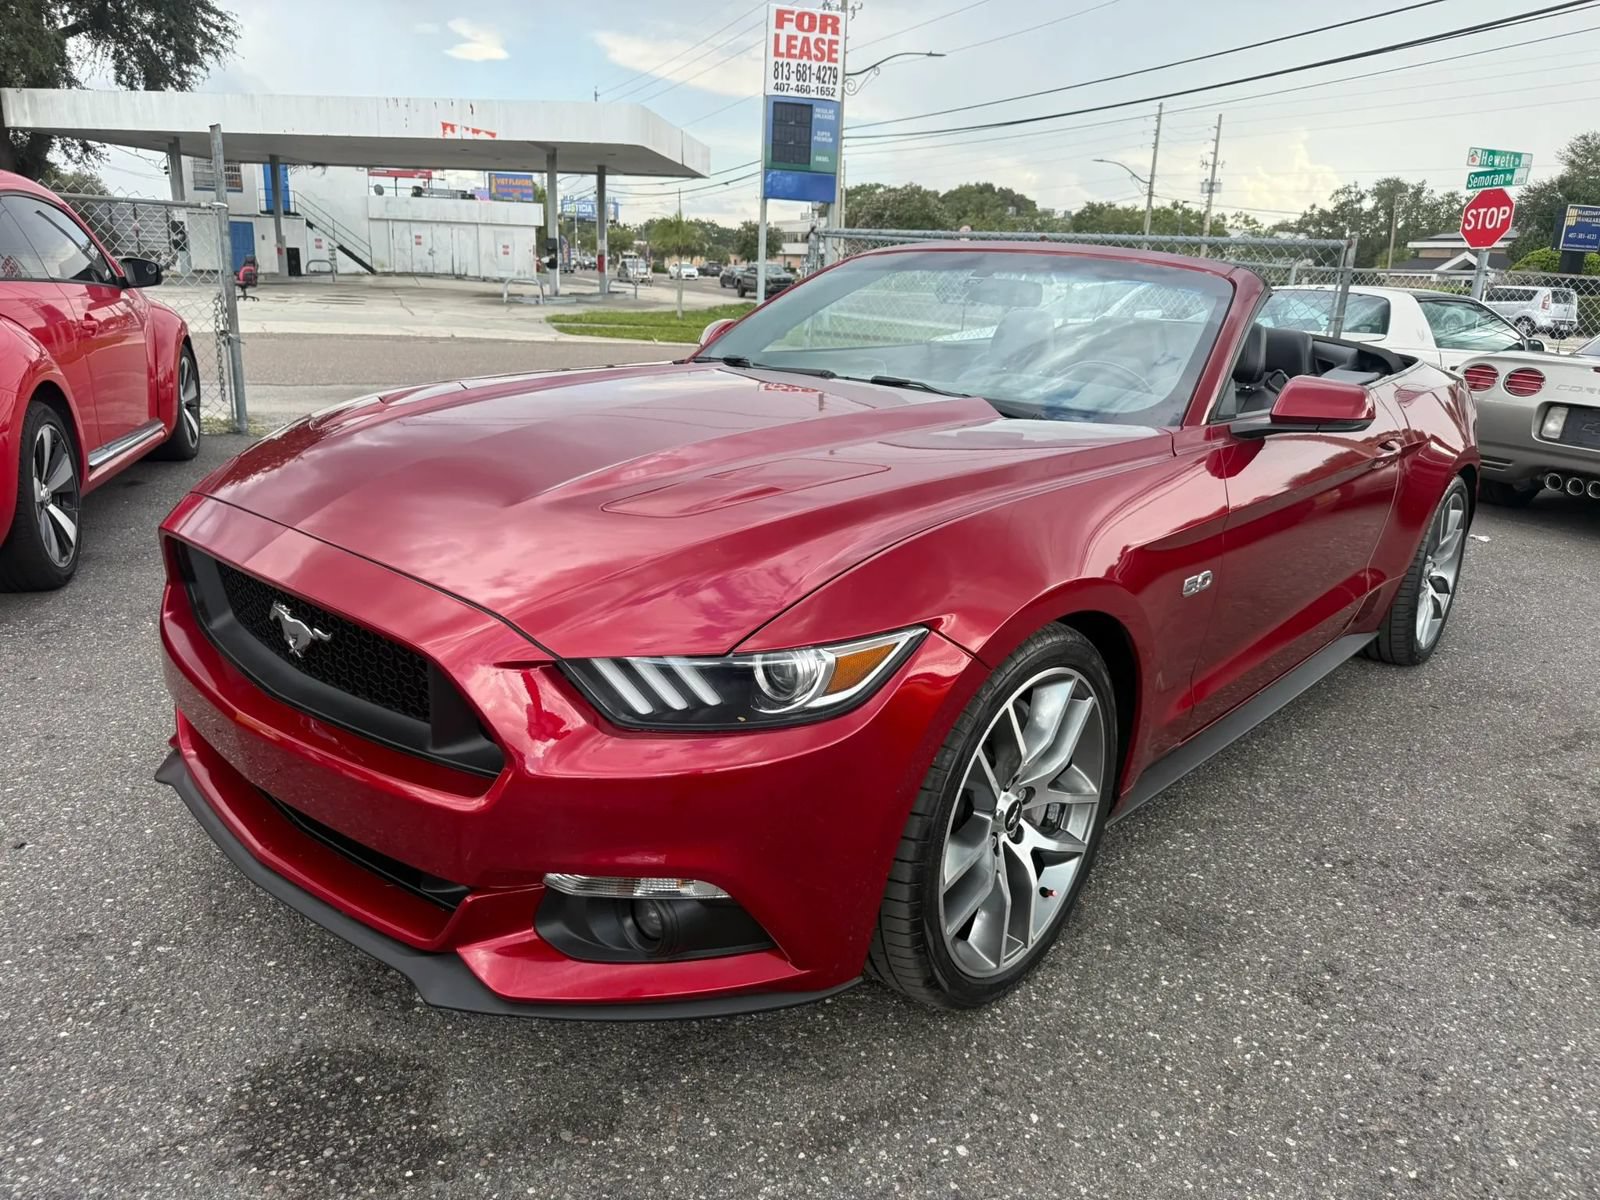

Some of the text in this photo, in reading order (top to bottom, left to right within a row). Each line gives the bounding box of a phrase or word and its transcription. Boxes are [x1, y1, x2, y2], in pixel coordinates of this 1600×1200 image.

[775, 8, 840, 36] FOR
[773, 33, 840, 64] LEASE
[773, 61, 838, 86] 813-681-4279
[773, 82, 836, 97] 407-460-1652
[1481, 151, 1513, 167] Hewett
[1468, 173, 1504, 188] Semoran
[1464, 205, 1511, 231] STOP
[1183, 570, 1212, 598] 5.0
